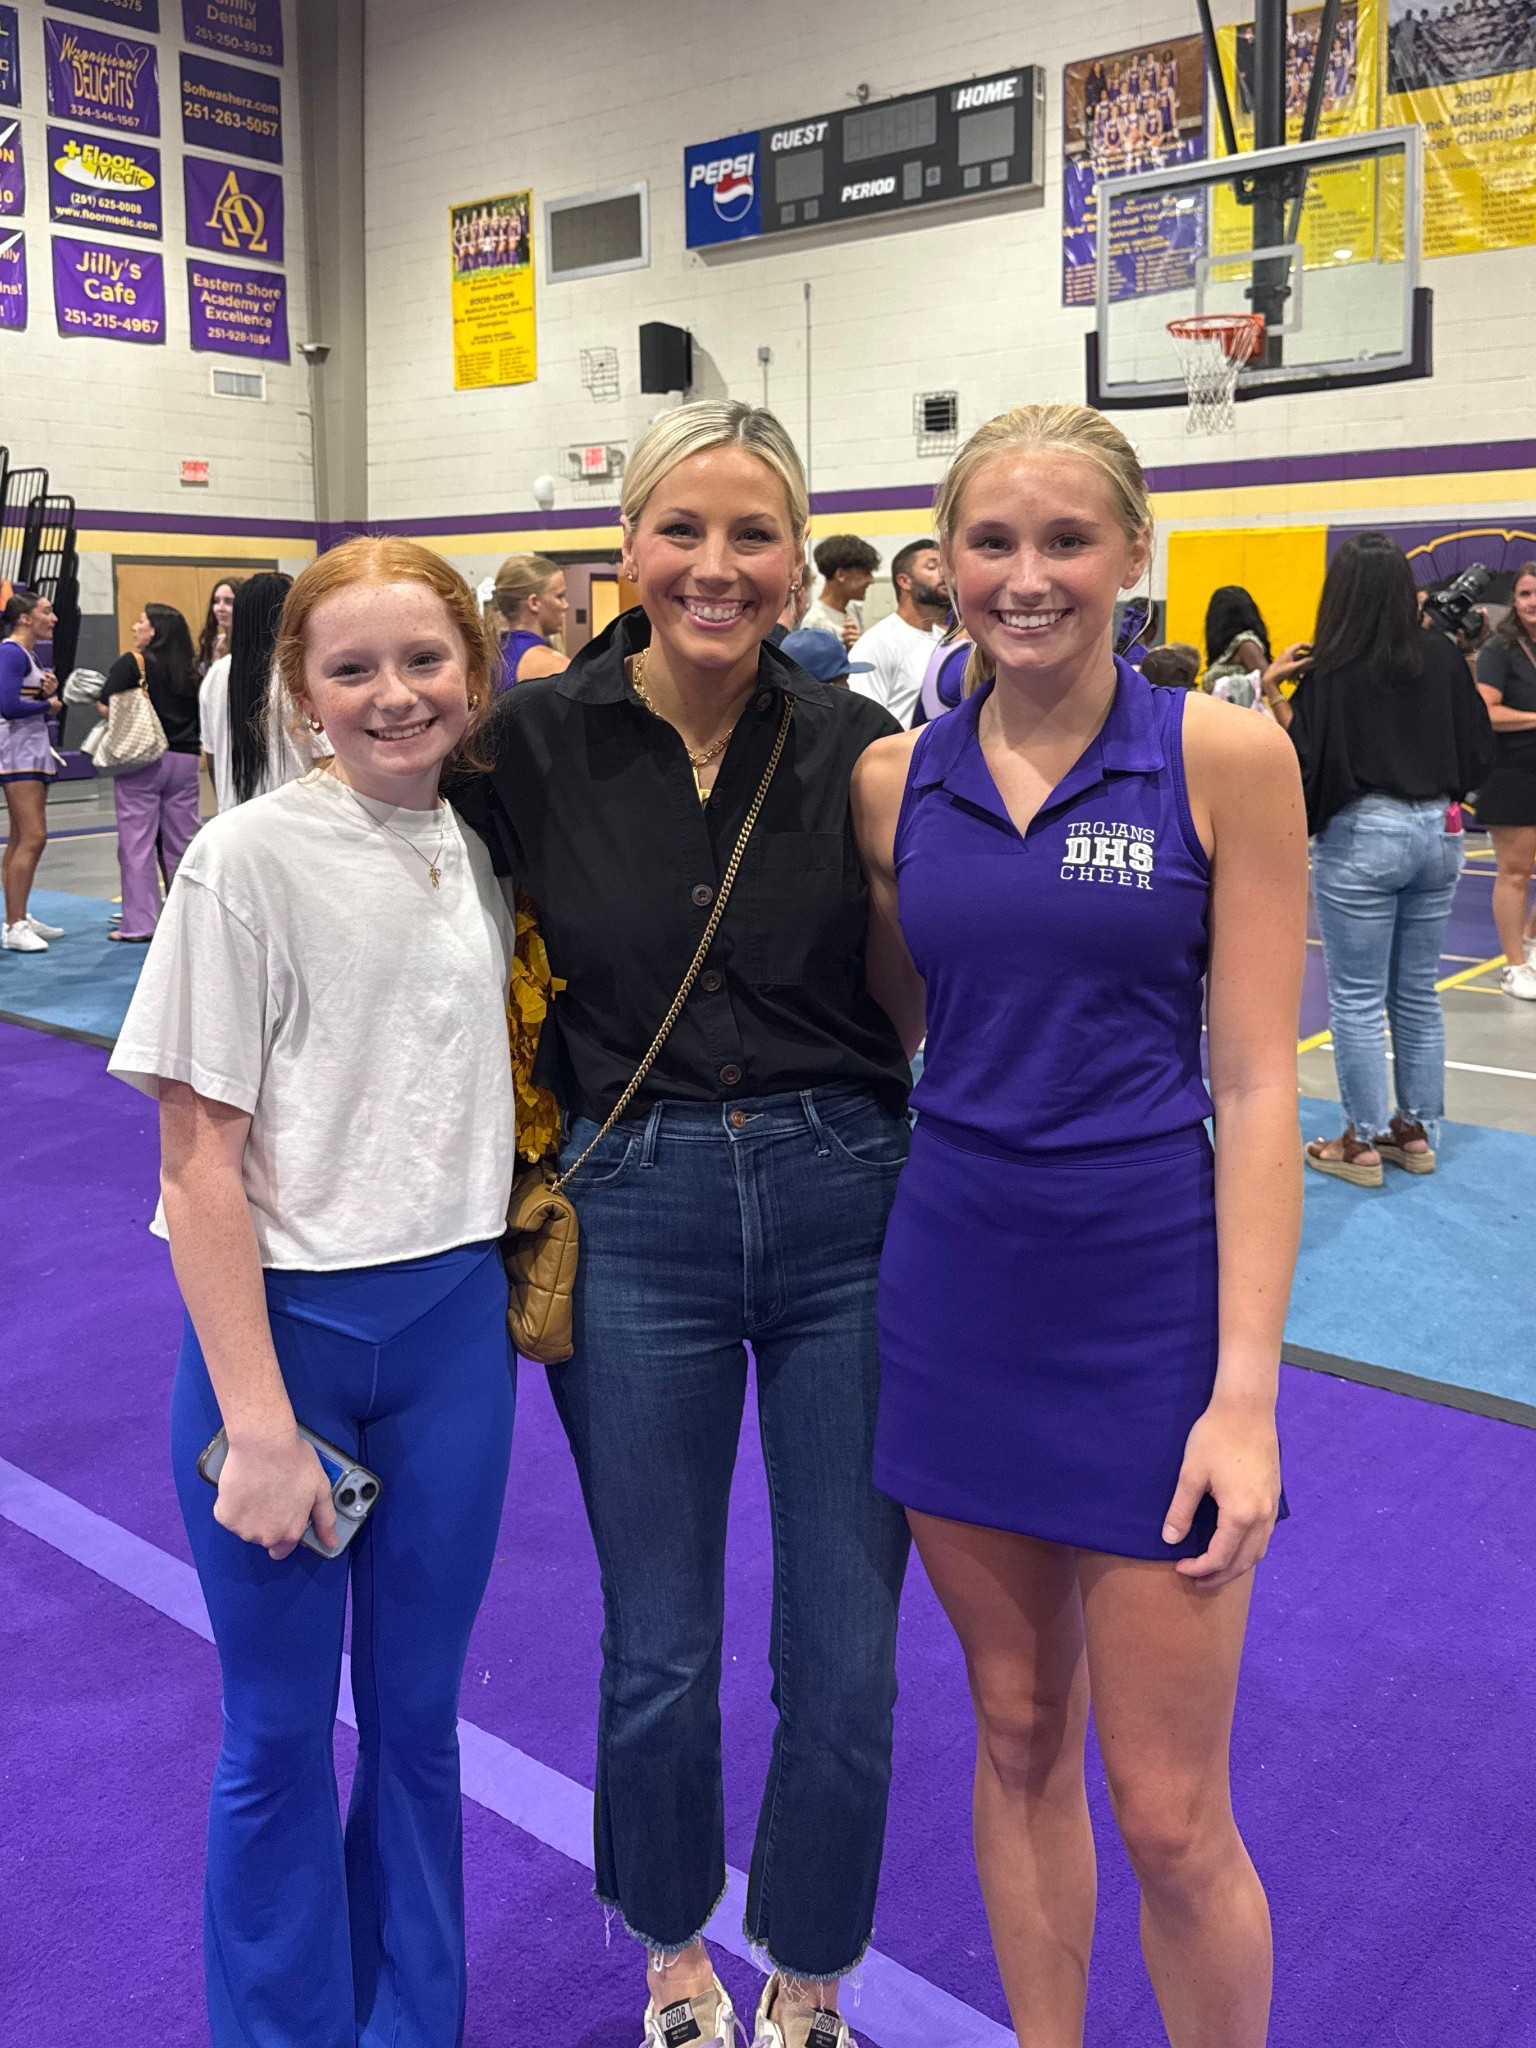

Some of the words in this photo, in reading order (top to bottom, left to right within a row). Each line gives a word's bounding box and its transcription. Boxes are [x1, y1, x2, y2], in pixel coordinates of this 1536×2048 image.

[207, 5, 256, 32] Dental
[72, 60, 135, 110] DELIGHTS
[183, 80, 279, 115] Softwasherz.com
[956, 76, 1019, 111] HOME
[1455, 88, 1493, 108] 2009
[184, 101, 279, 137] 251-263-5057
[770, 121, 829, 152] GUEST
[82, 143, 135, 171] Floor
[689, 152, 756, 189] PEPSI
[94, 164, 149, 188] Medic
[841, 176, 896, 203] PERIOD
[70, 192, 97, 208] (251)
[55, 206, 158, 232] www.floormedic.com
[75, 251, 142, 281] Jilly's
[84, 278, 137, 305] Cafe
[193, 272, 243, 294] Eastern
[246, 282, 282, 300] Shore
[200, 290, 260, 313] Academy
[263, 300, 277, 318] of
[205, 305, 273, 328] Excellence
[64, 307, 160, 334] 251-215-4967
[1067, 821, 1155, 843] TROJANS
[1062, 836, 1155, 873] DHS
[1060, 865, 1153, 890] CHEER
[665, 2006, 687, 2029] GGDB
